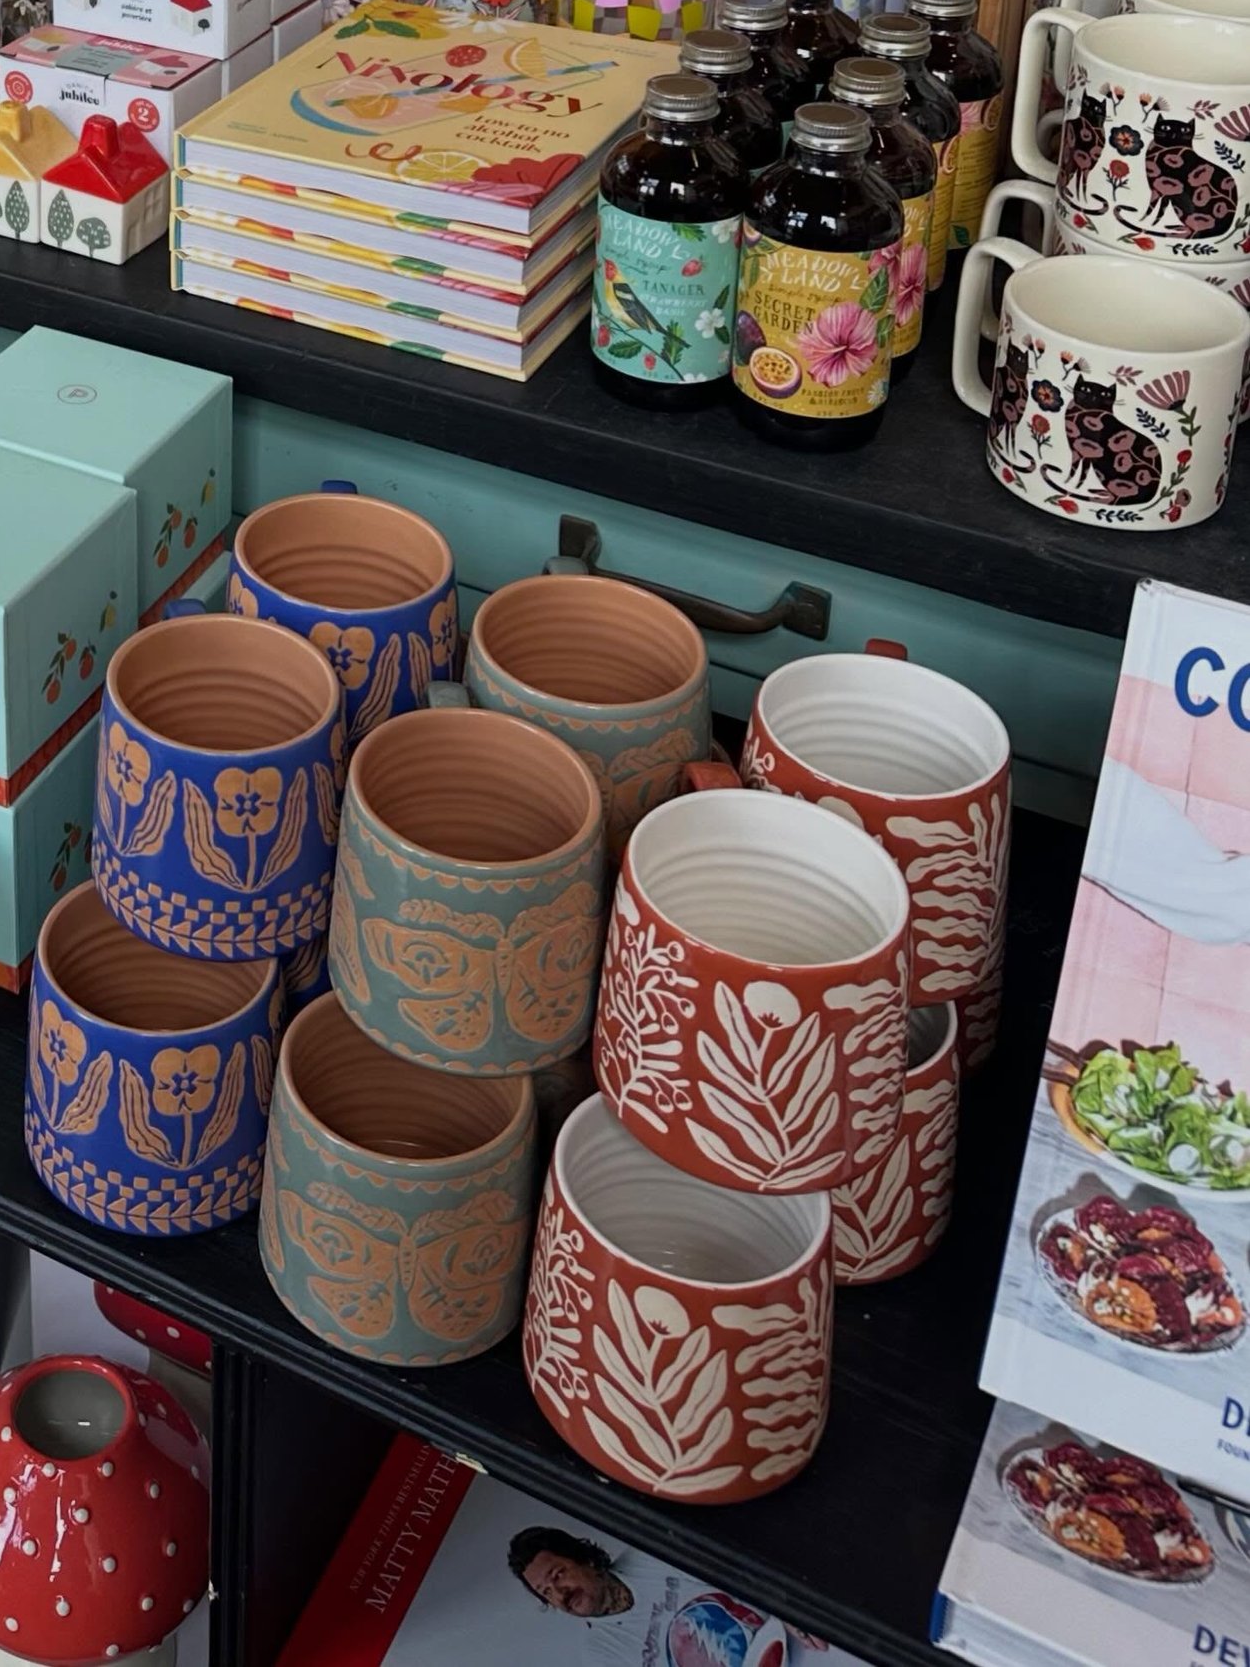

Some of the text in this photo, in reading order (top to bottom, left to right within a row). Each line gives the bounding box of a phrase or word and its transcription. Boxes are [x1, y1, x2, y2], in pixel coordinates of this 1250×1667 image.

[316, 48, 603, 118] Nixology
[137, 106, 149, 121] 2
[455, 132, 542, 154] cocktails
[463, 124, 540, 143] alcohol
[613, 234, 663, 259] LAND
[643, 279, 706, 296] TANAGER
[781, 269, 841, 292] LAND
[754, 290, 817, 321] SECRET
[753, 306, 815, 335] GARDEN
[1216, 1438, 1250, 1462] FOUN
[364, 1452, 461, 1614] MATTY MATH
